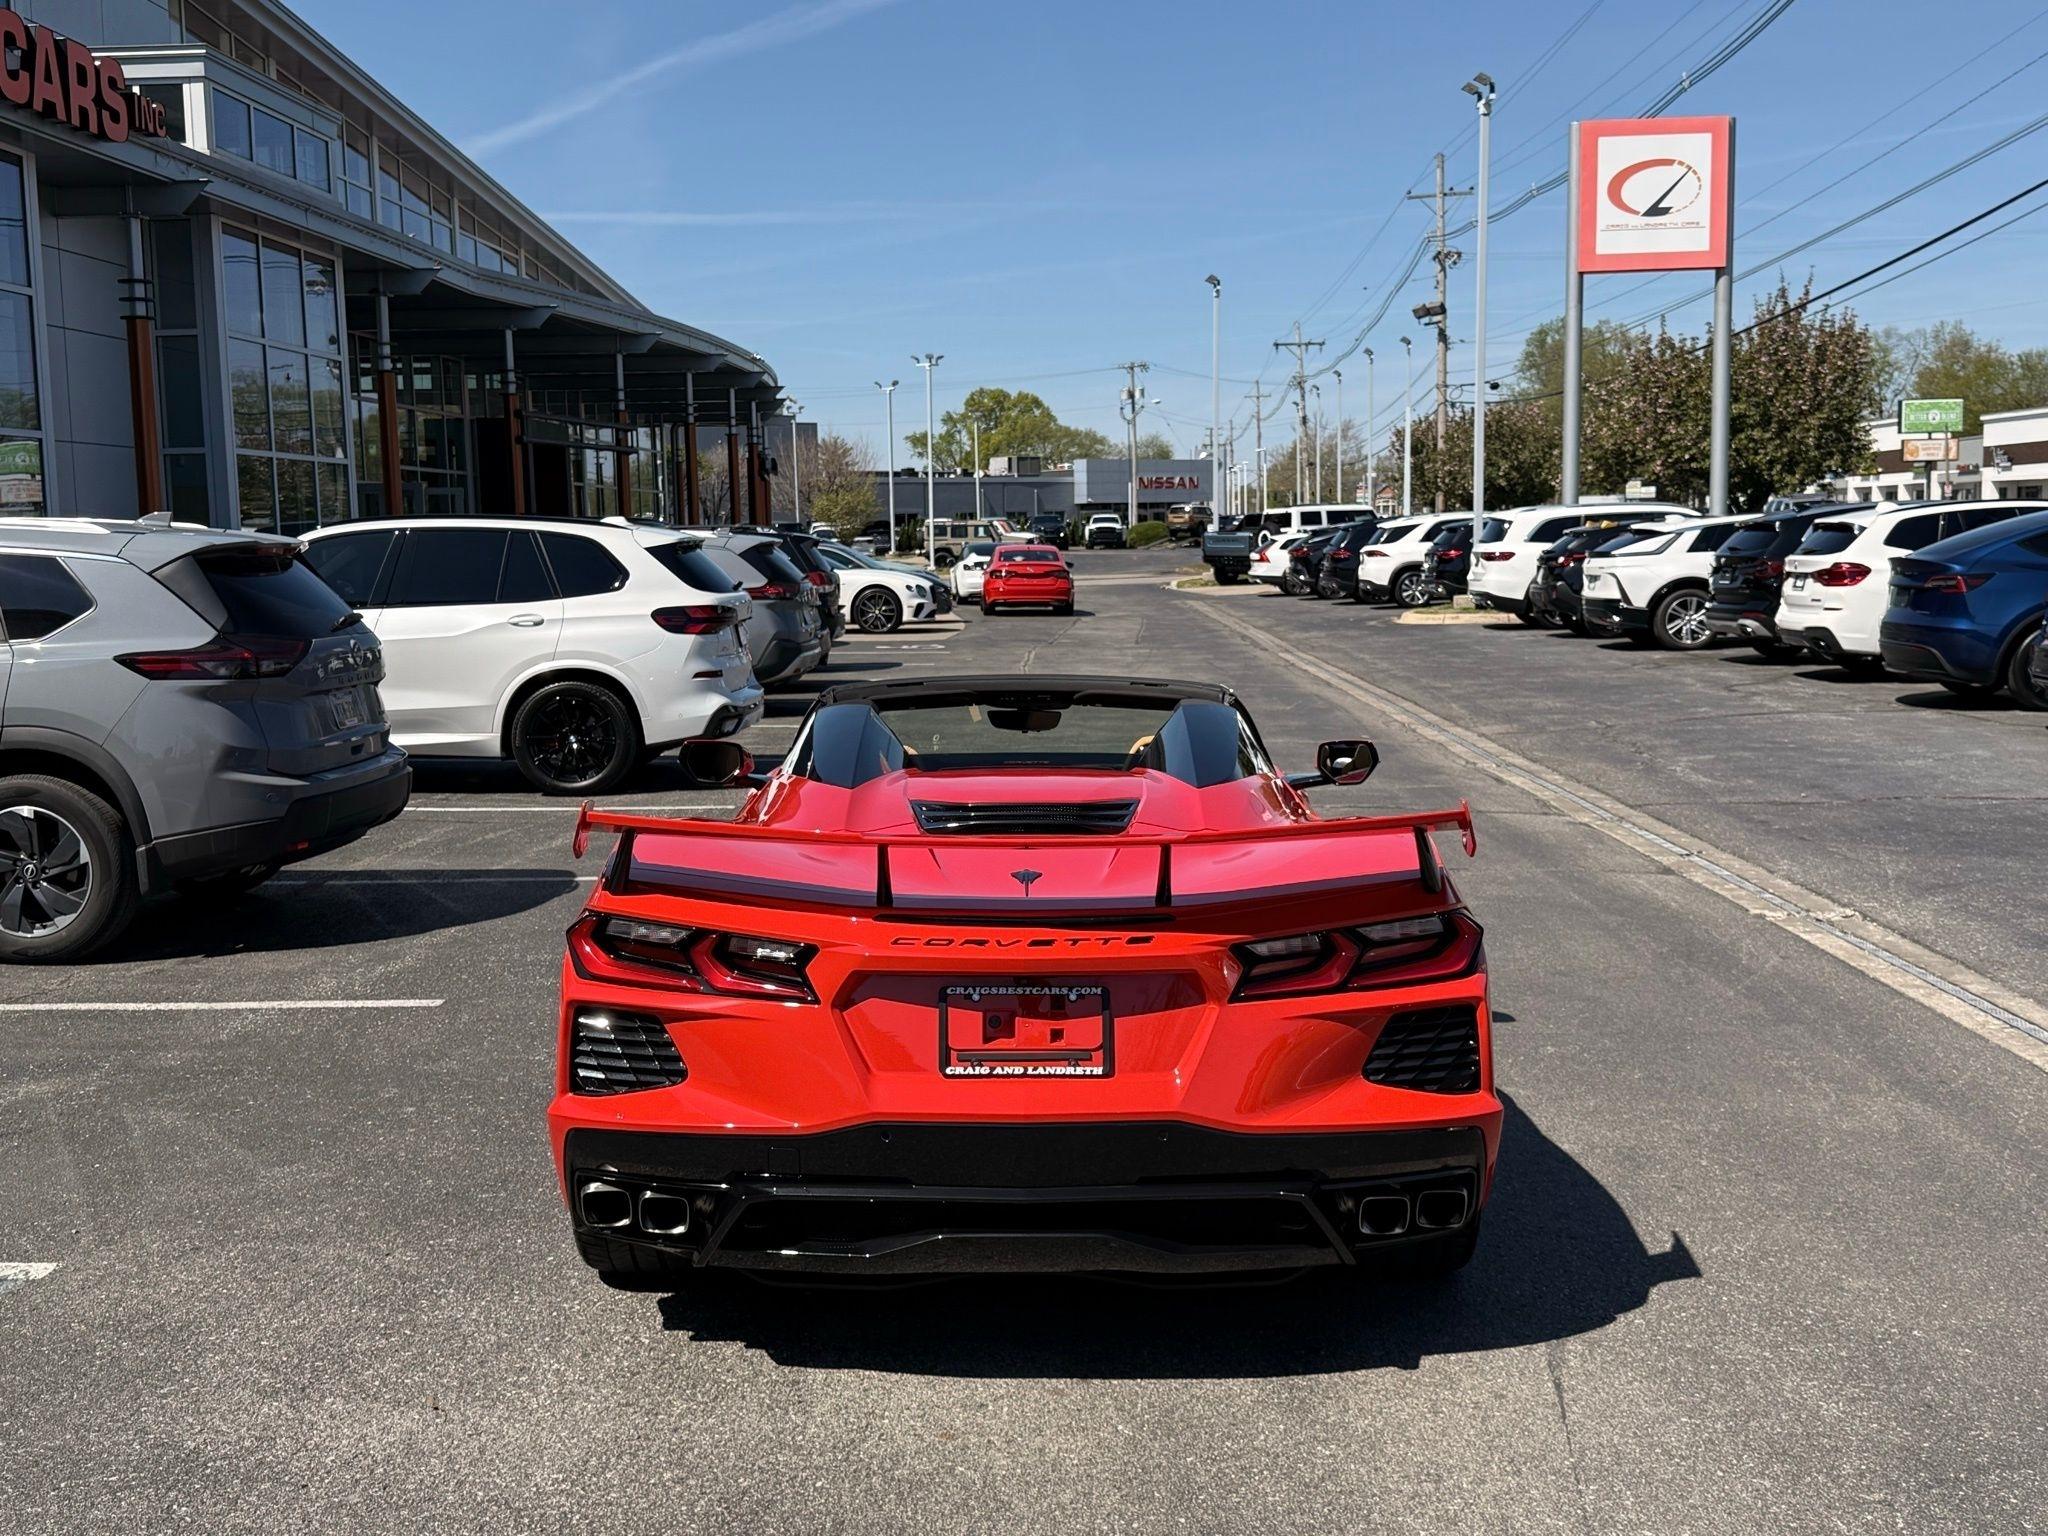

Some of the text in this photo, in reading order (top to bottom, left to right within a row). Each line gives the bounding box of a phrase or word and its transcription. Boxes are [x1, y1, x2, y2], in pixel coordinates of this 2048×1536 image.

[0, 7, 129, 142] CARS
[1137, 476, 1199, 489] NISSAN
[890, 935, 1156, 947] CORVETTE
[946, 986, 1103, 995] CRAIGSBESTCARS.COM
[945, 1066, 1104, 1075] CRAIG AND LANDRETH
